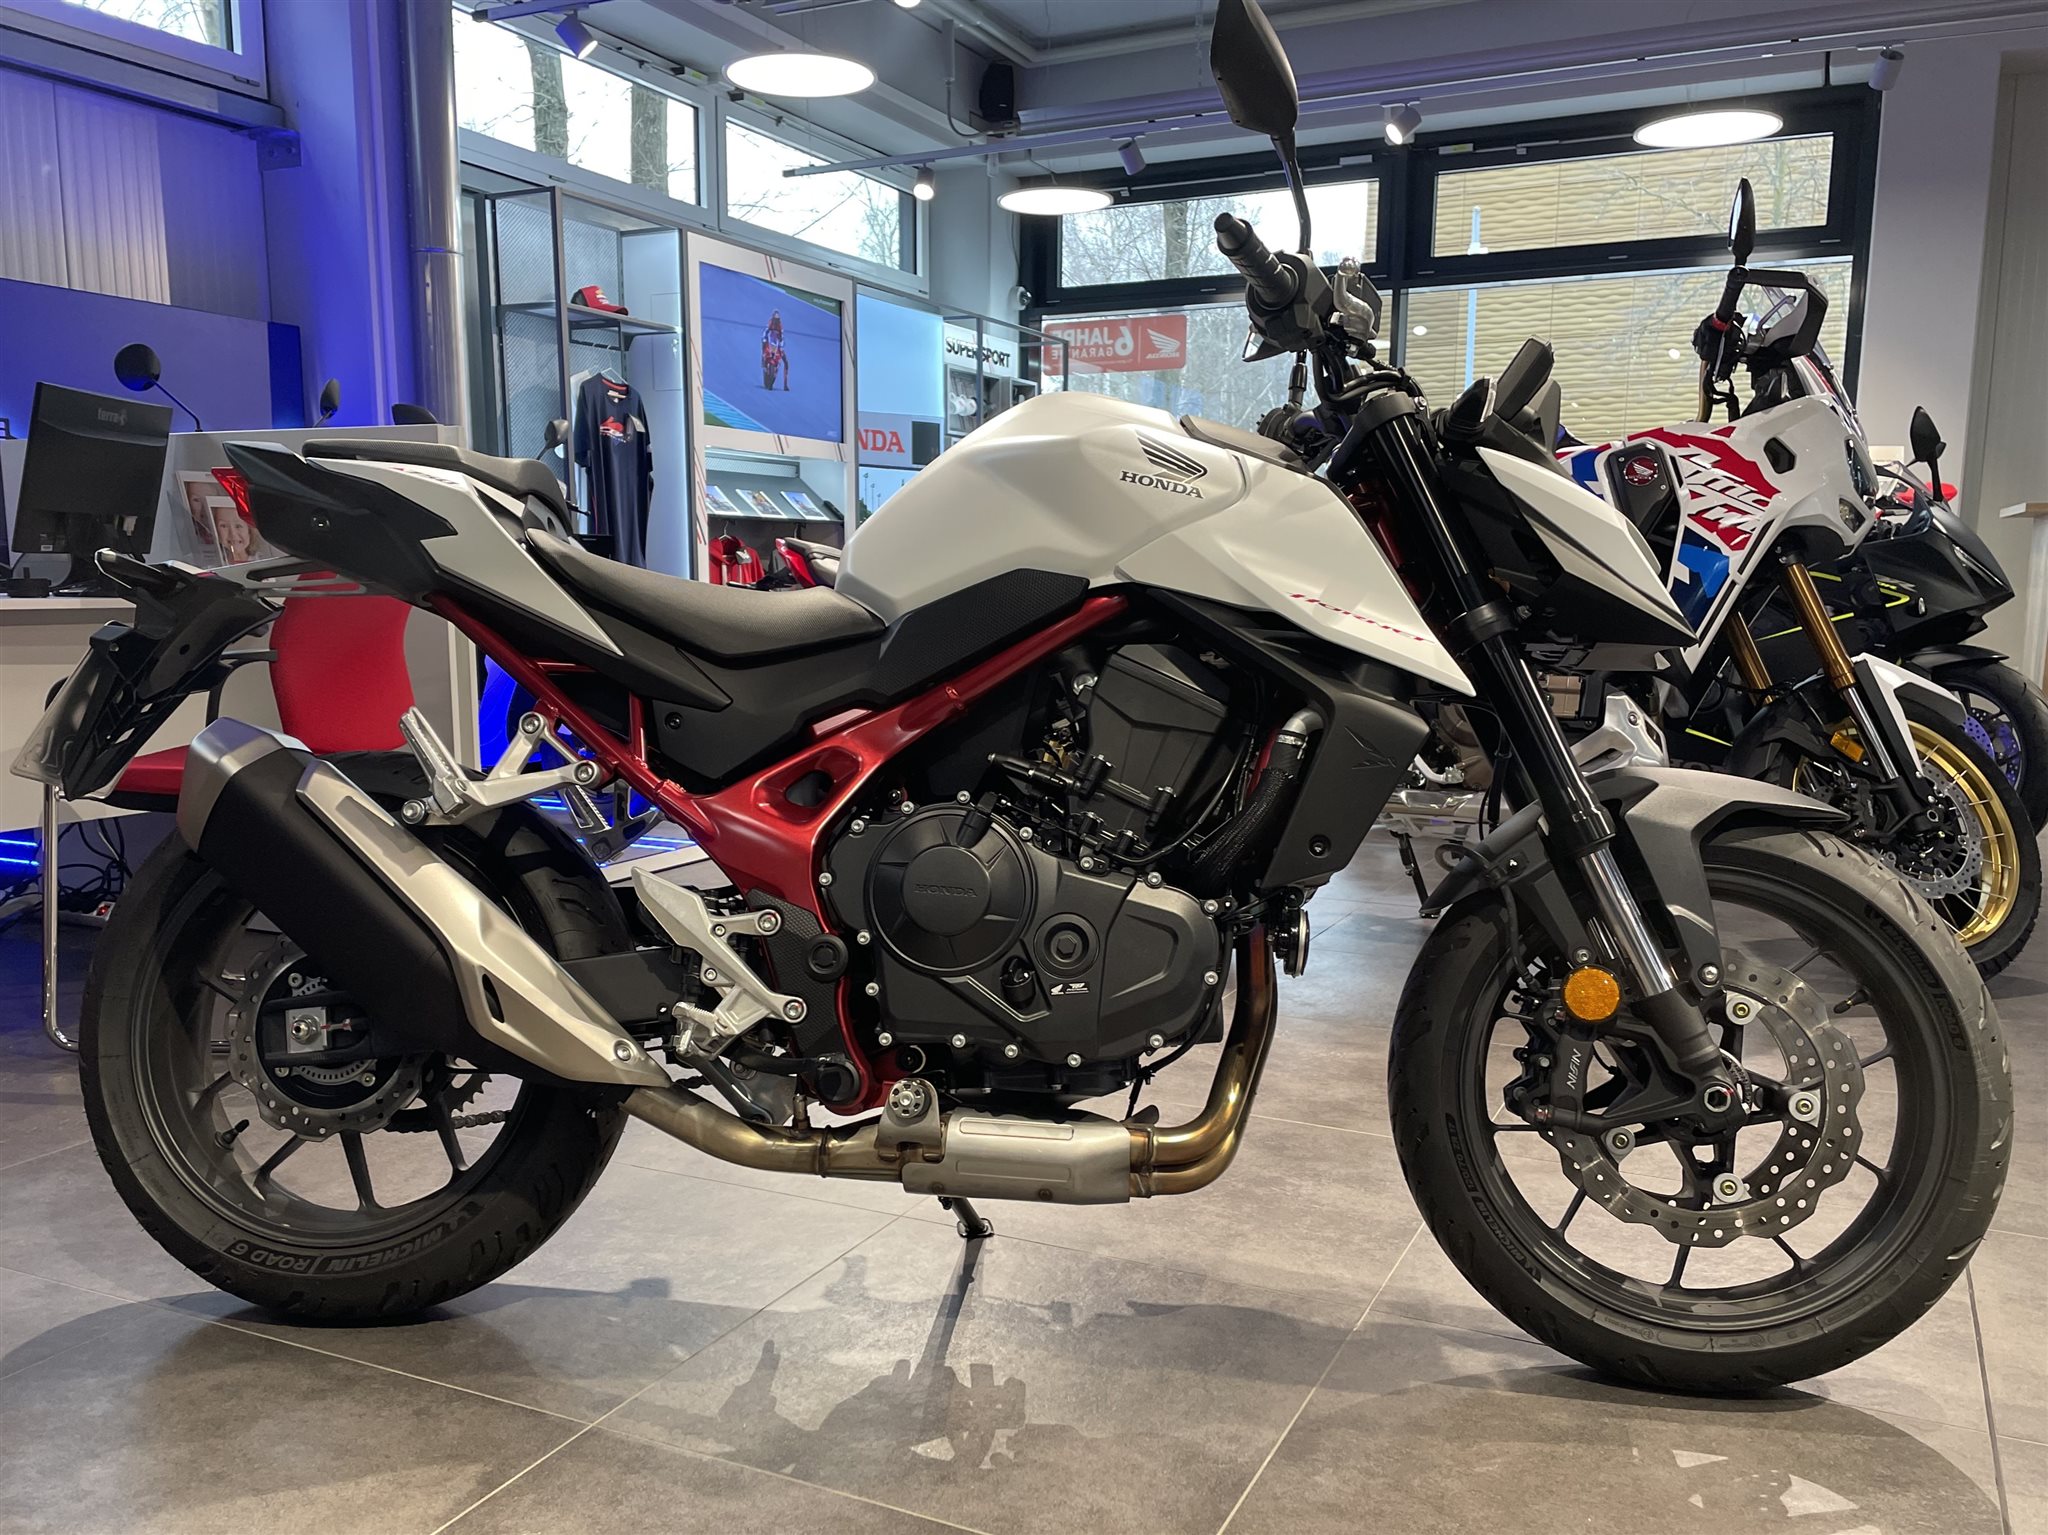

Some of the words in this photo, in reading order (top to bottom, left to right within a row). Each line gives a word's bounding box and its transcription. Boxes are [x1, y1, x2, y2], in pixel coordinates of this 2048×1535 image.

[1120, 471, 1204, 499] HONDA
[913, 883, 978, 898] HONDA
[1566, 1048, 1581, 1090] NISSIN
[231, 1243, 246, 1256] 6
[249, 1249, 310, 1271] ROAD
[326, 1223, 444, 1272] MICHELIN
